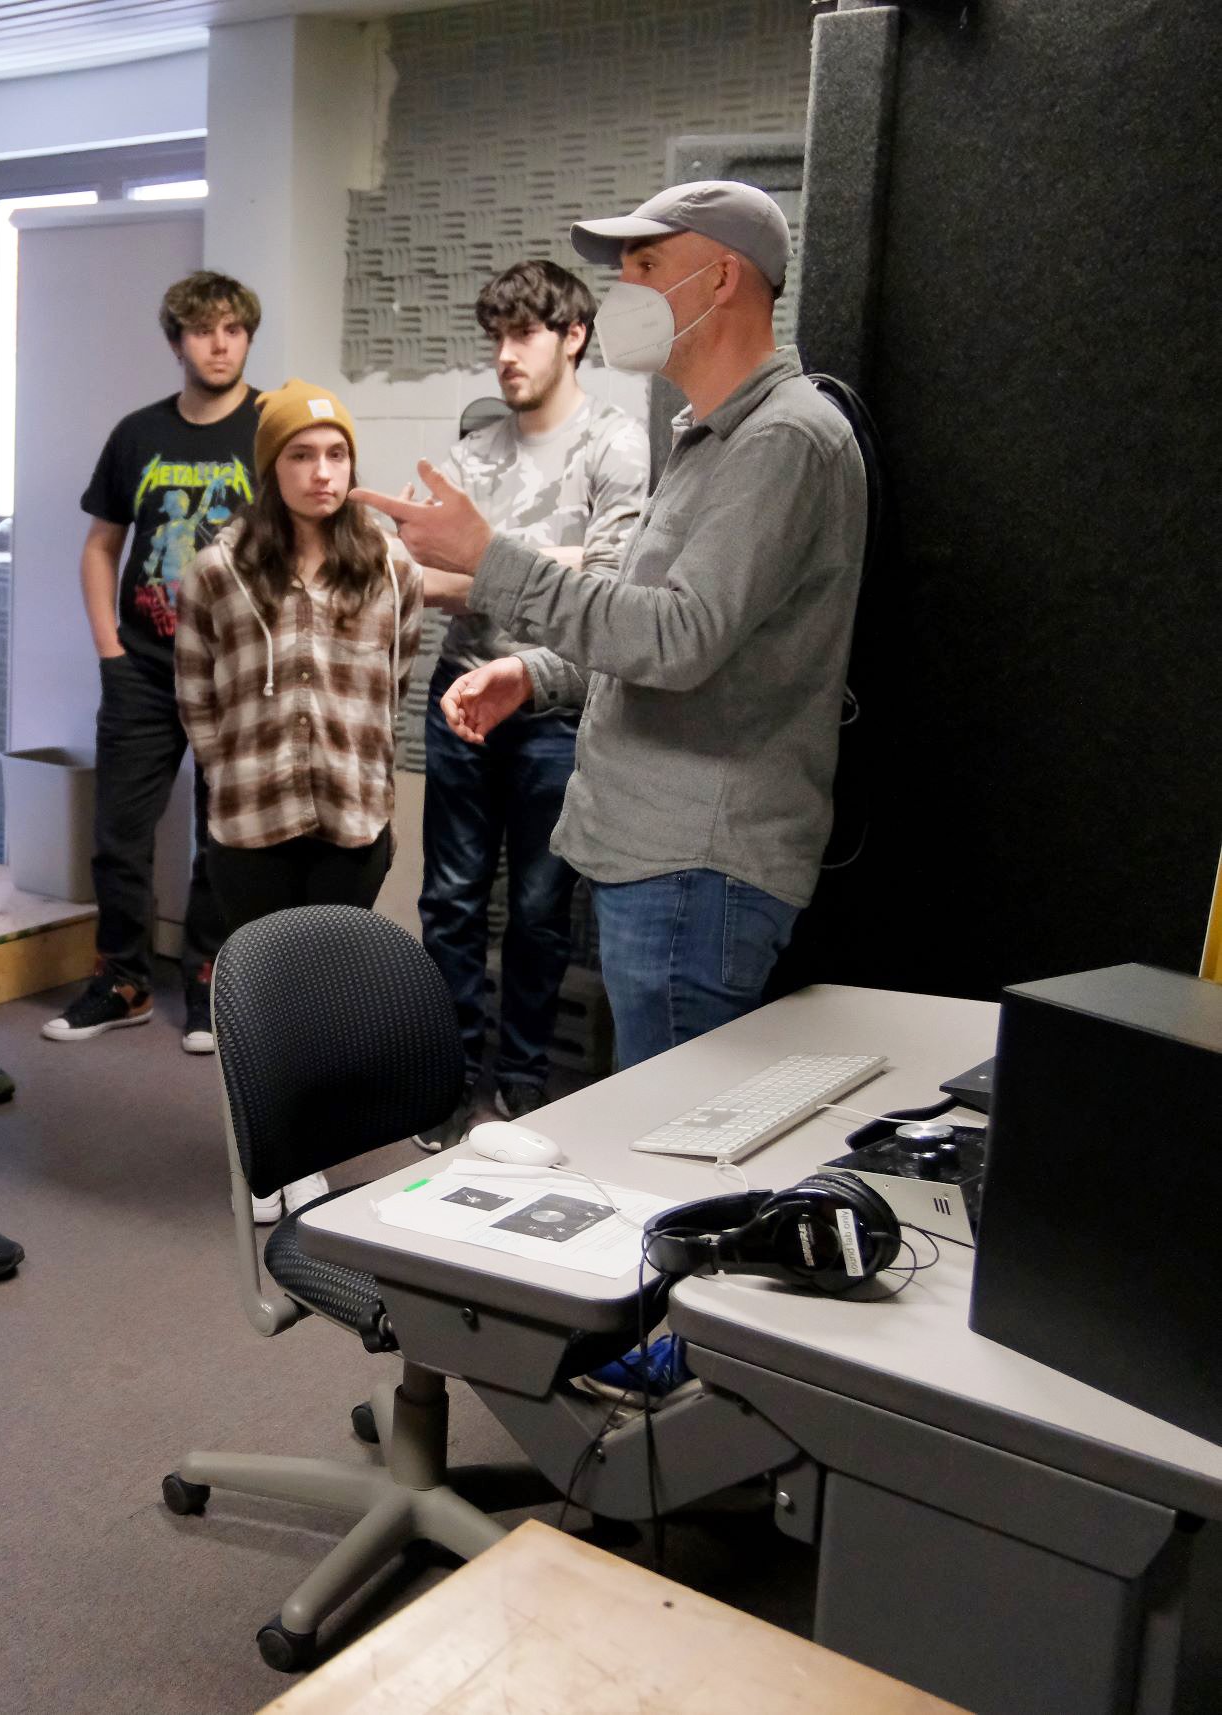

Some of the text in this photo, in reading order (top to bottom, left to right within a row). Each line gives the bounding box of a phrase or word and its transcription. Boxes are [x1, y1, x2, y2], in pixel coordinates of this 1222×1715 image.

[134, 453, 255, 516] METALLICA
[841, 1210, 859, 1274] sound lab only
